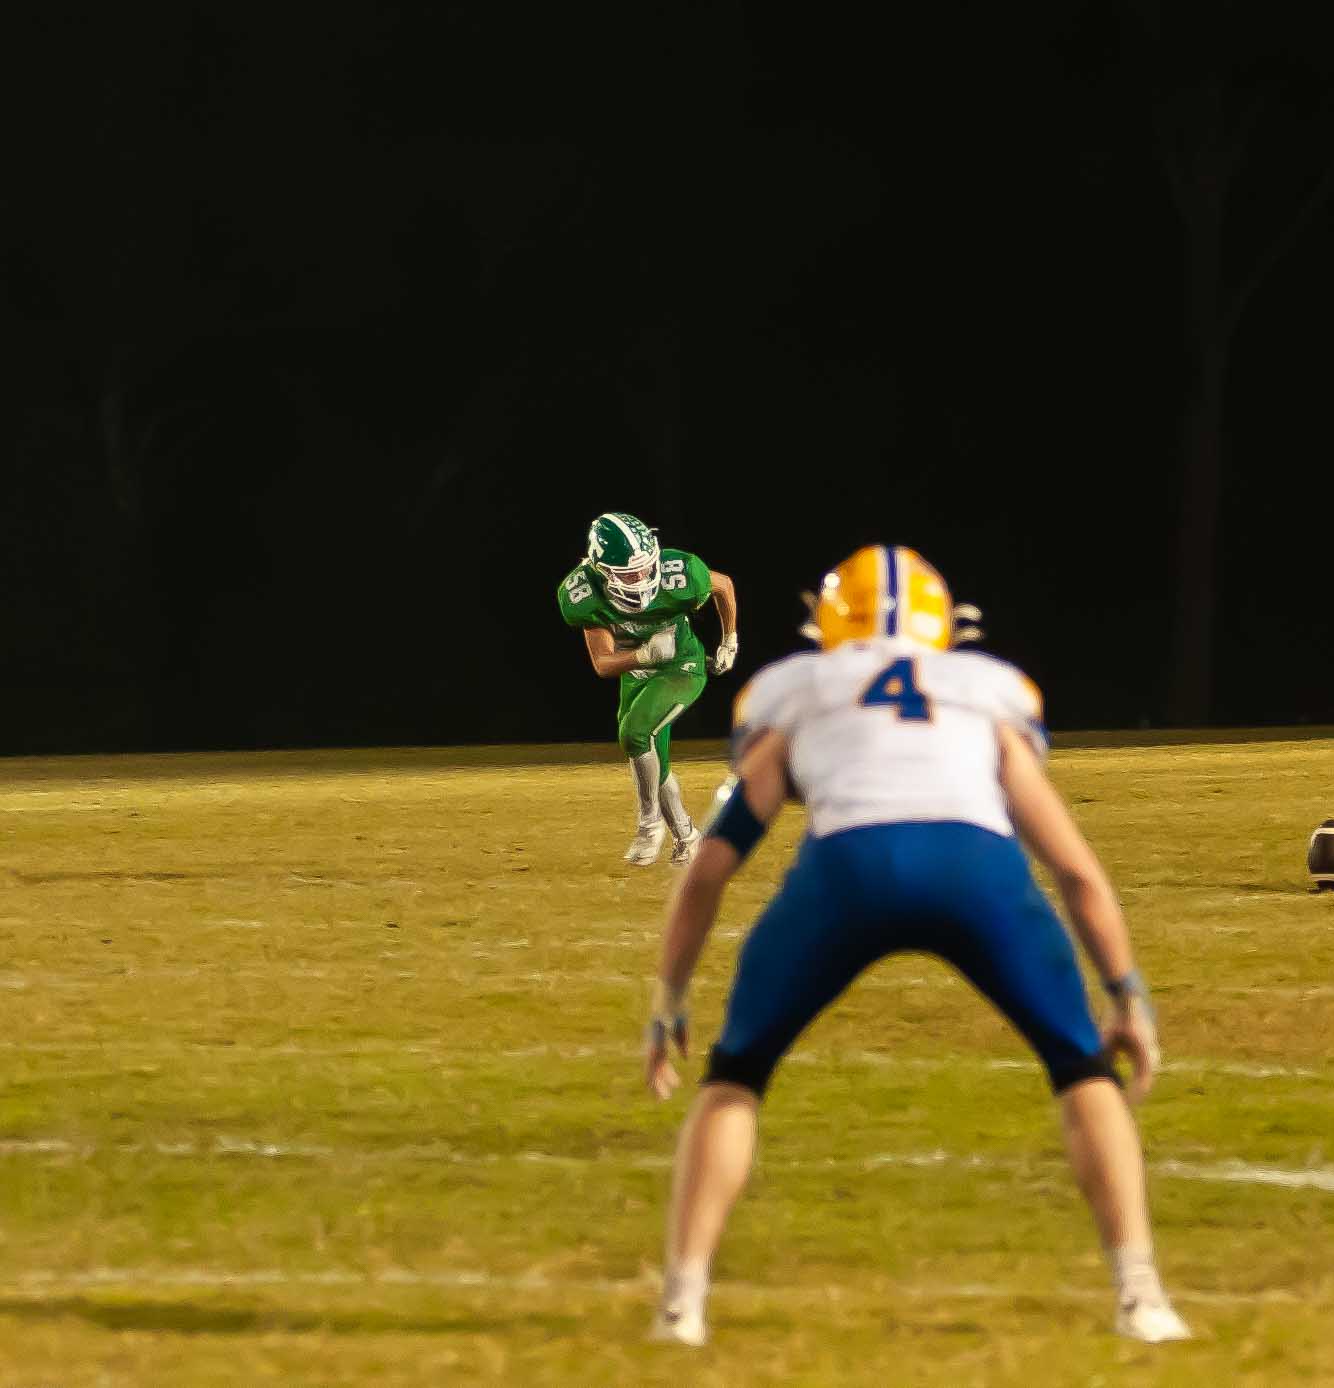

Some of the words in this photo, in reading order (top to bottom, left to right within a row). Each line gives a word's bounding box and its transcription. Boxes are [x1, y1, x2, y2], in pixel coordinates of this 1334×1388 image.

[565, 571, 593, 605] 58
[660, 559, 688, 591] 58
[858, 656, 933, 723] 4
